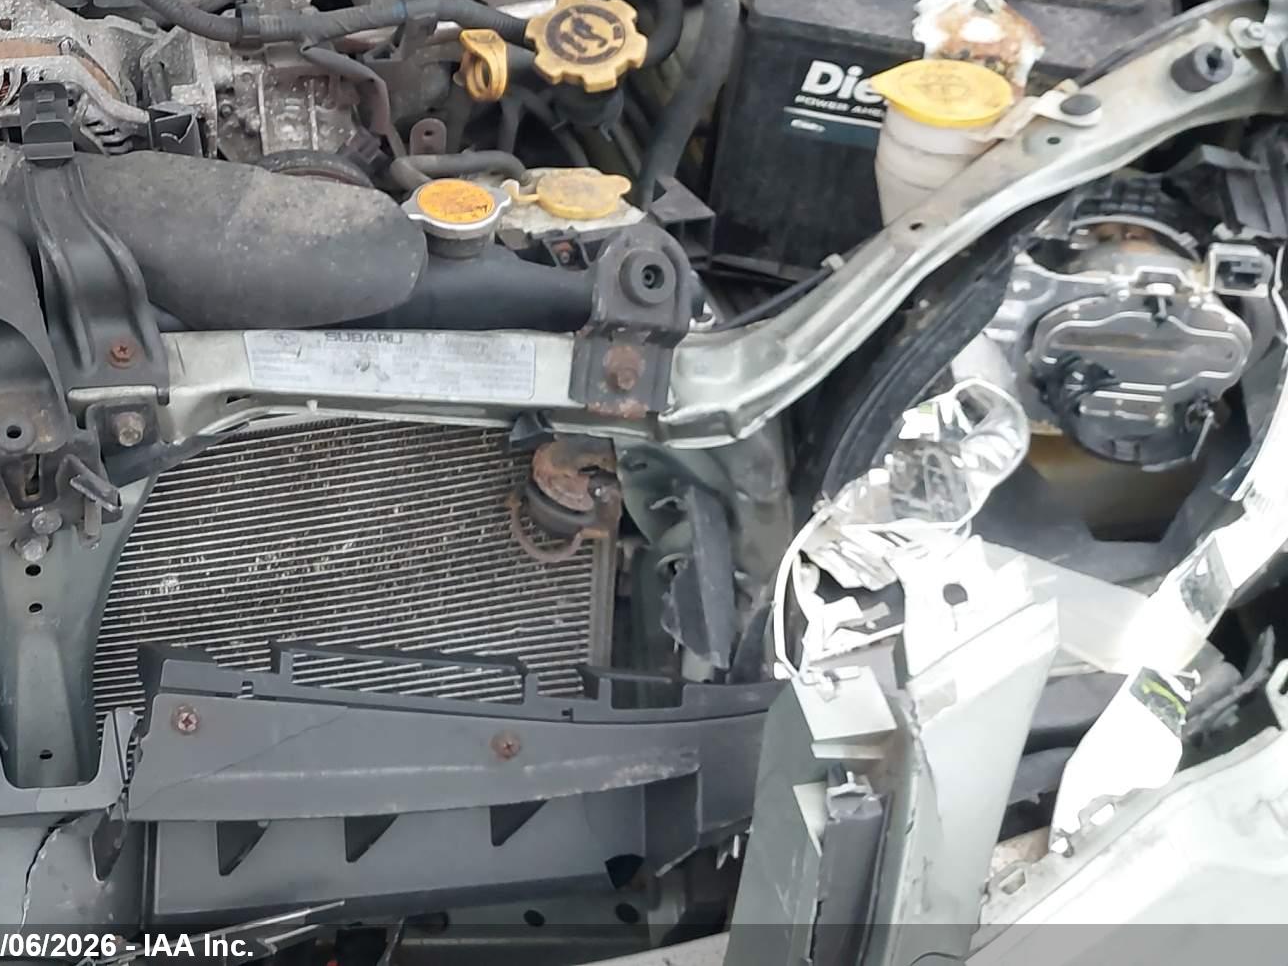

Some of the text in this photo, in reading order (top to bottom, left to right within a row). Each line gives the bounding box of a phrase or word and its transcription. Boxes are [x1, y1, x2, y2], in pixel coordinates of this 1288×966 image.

[801, 60, 889, 105] Die
[795, 94, 850, 112] POWER
[324, 331, 404, 345] SUBARU
